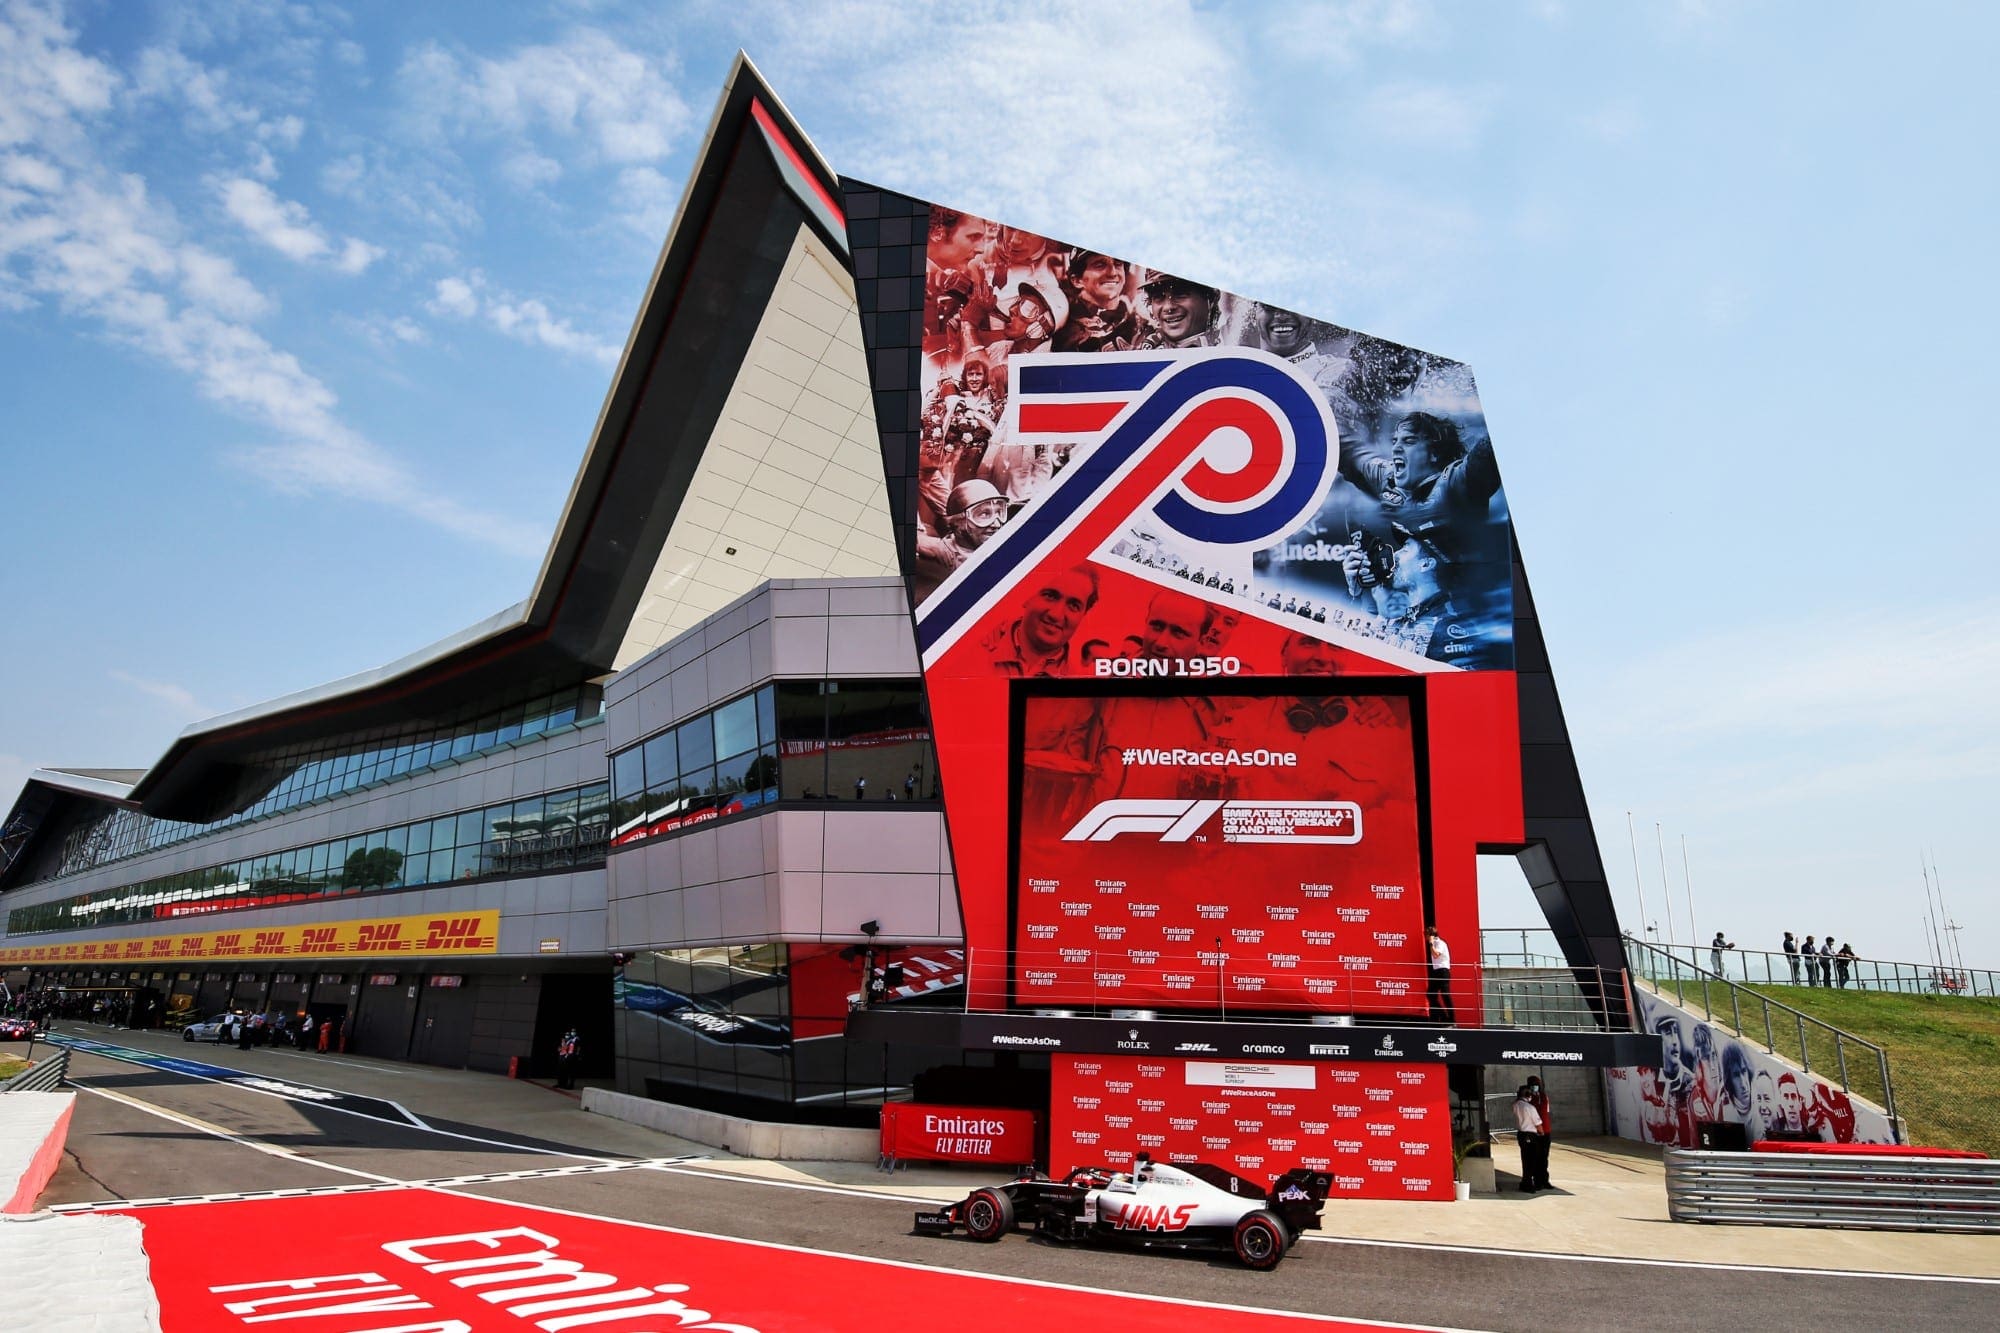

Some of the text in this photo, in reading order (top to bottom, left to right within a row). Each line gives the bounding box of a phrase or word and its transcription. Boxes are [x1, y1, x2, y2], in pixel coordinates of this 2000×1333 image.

[1095, 656, 1240, 676] BORN 1950
[1122, 748, 1297, 766] #WeRaceAsOne
[1222, 809, 1282, 818] EMIRATES
[1284, 809, 1344, 819] FORMULA
[1223, 817, 1342, 827] 70TH ANNIVERSARY
[1222, 825, 1295, 834] GRAND PRIX
[1029, 879, 1059, 887] Emirates
[1096, 880, 1126, 888] Emirates
[1301, 883, 1333, 891] Emirates
[1371, 885, 1404, 893] Emirates
[1061, 902, 1092, 910] Emirates
[1128, 903, 1159, 911] Emirates
[1197, 905, 1228, 913] Emirates
[1267, 906, 1299, 914] Emirates
[1337, 908, 1370, 916] Emirates
[425, 918, 481, 948] DHL
[1028, 925, 1058, 933] Emirates
[1095, 926, 1126, 934] Emirates
[1163, 927, 1194, 935] Emirates
[1232, 929, 1264, 937] Emirates
[357, 924, 401, 950] DHL
[1302, 930, 1335, 939] Emirates
[1374, 932, 1407, 940] Emirates
[215, 934, 241, 955] DHL
[254, 932, 284, 954] DHL
[301, 928, 337, 952] DHL
[126, 942, 144, 958] DHL
[152, 940, 172, 957] DHL
[182, 938, 204, 956] DHL
[992, 1036, 1061, 1046] #WeRaceAsOne
[1117, 1041, 1150, 1049] ROLEX
[1178, 1043, 1212, 1052] DHL
[1242, 1043, 1285, 1053] aramco
[1309, 1044, 1350, 1055] PIRELLI
[1374, 1049, 1404, 1057] Emirates
[1502, 1050, 1583, 1061] #PURPOSEDRIVEN
[1221, 1089, 1276, 1097] #WeRaceAsOne
[925, 1115, 1005, 1135] Emirates
[936, 1137, 992, 1155] FLY BETTER
[1230, 1177, 1239, 1192] 8
[1278, 1190, 1311, 1202] PEAK
[1104, 1203, 1200, 1233] HAAS
